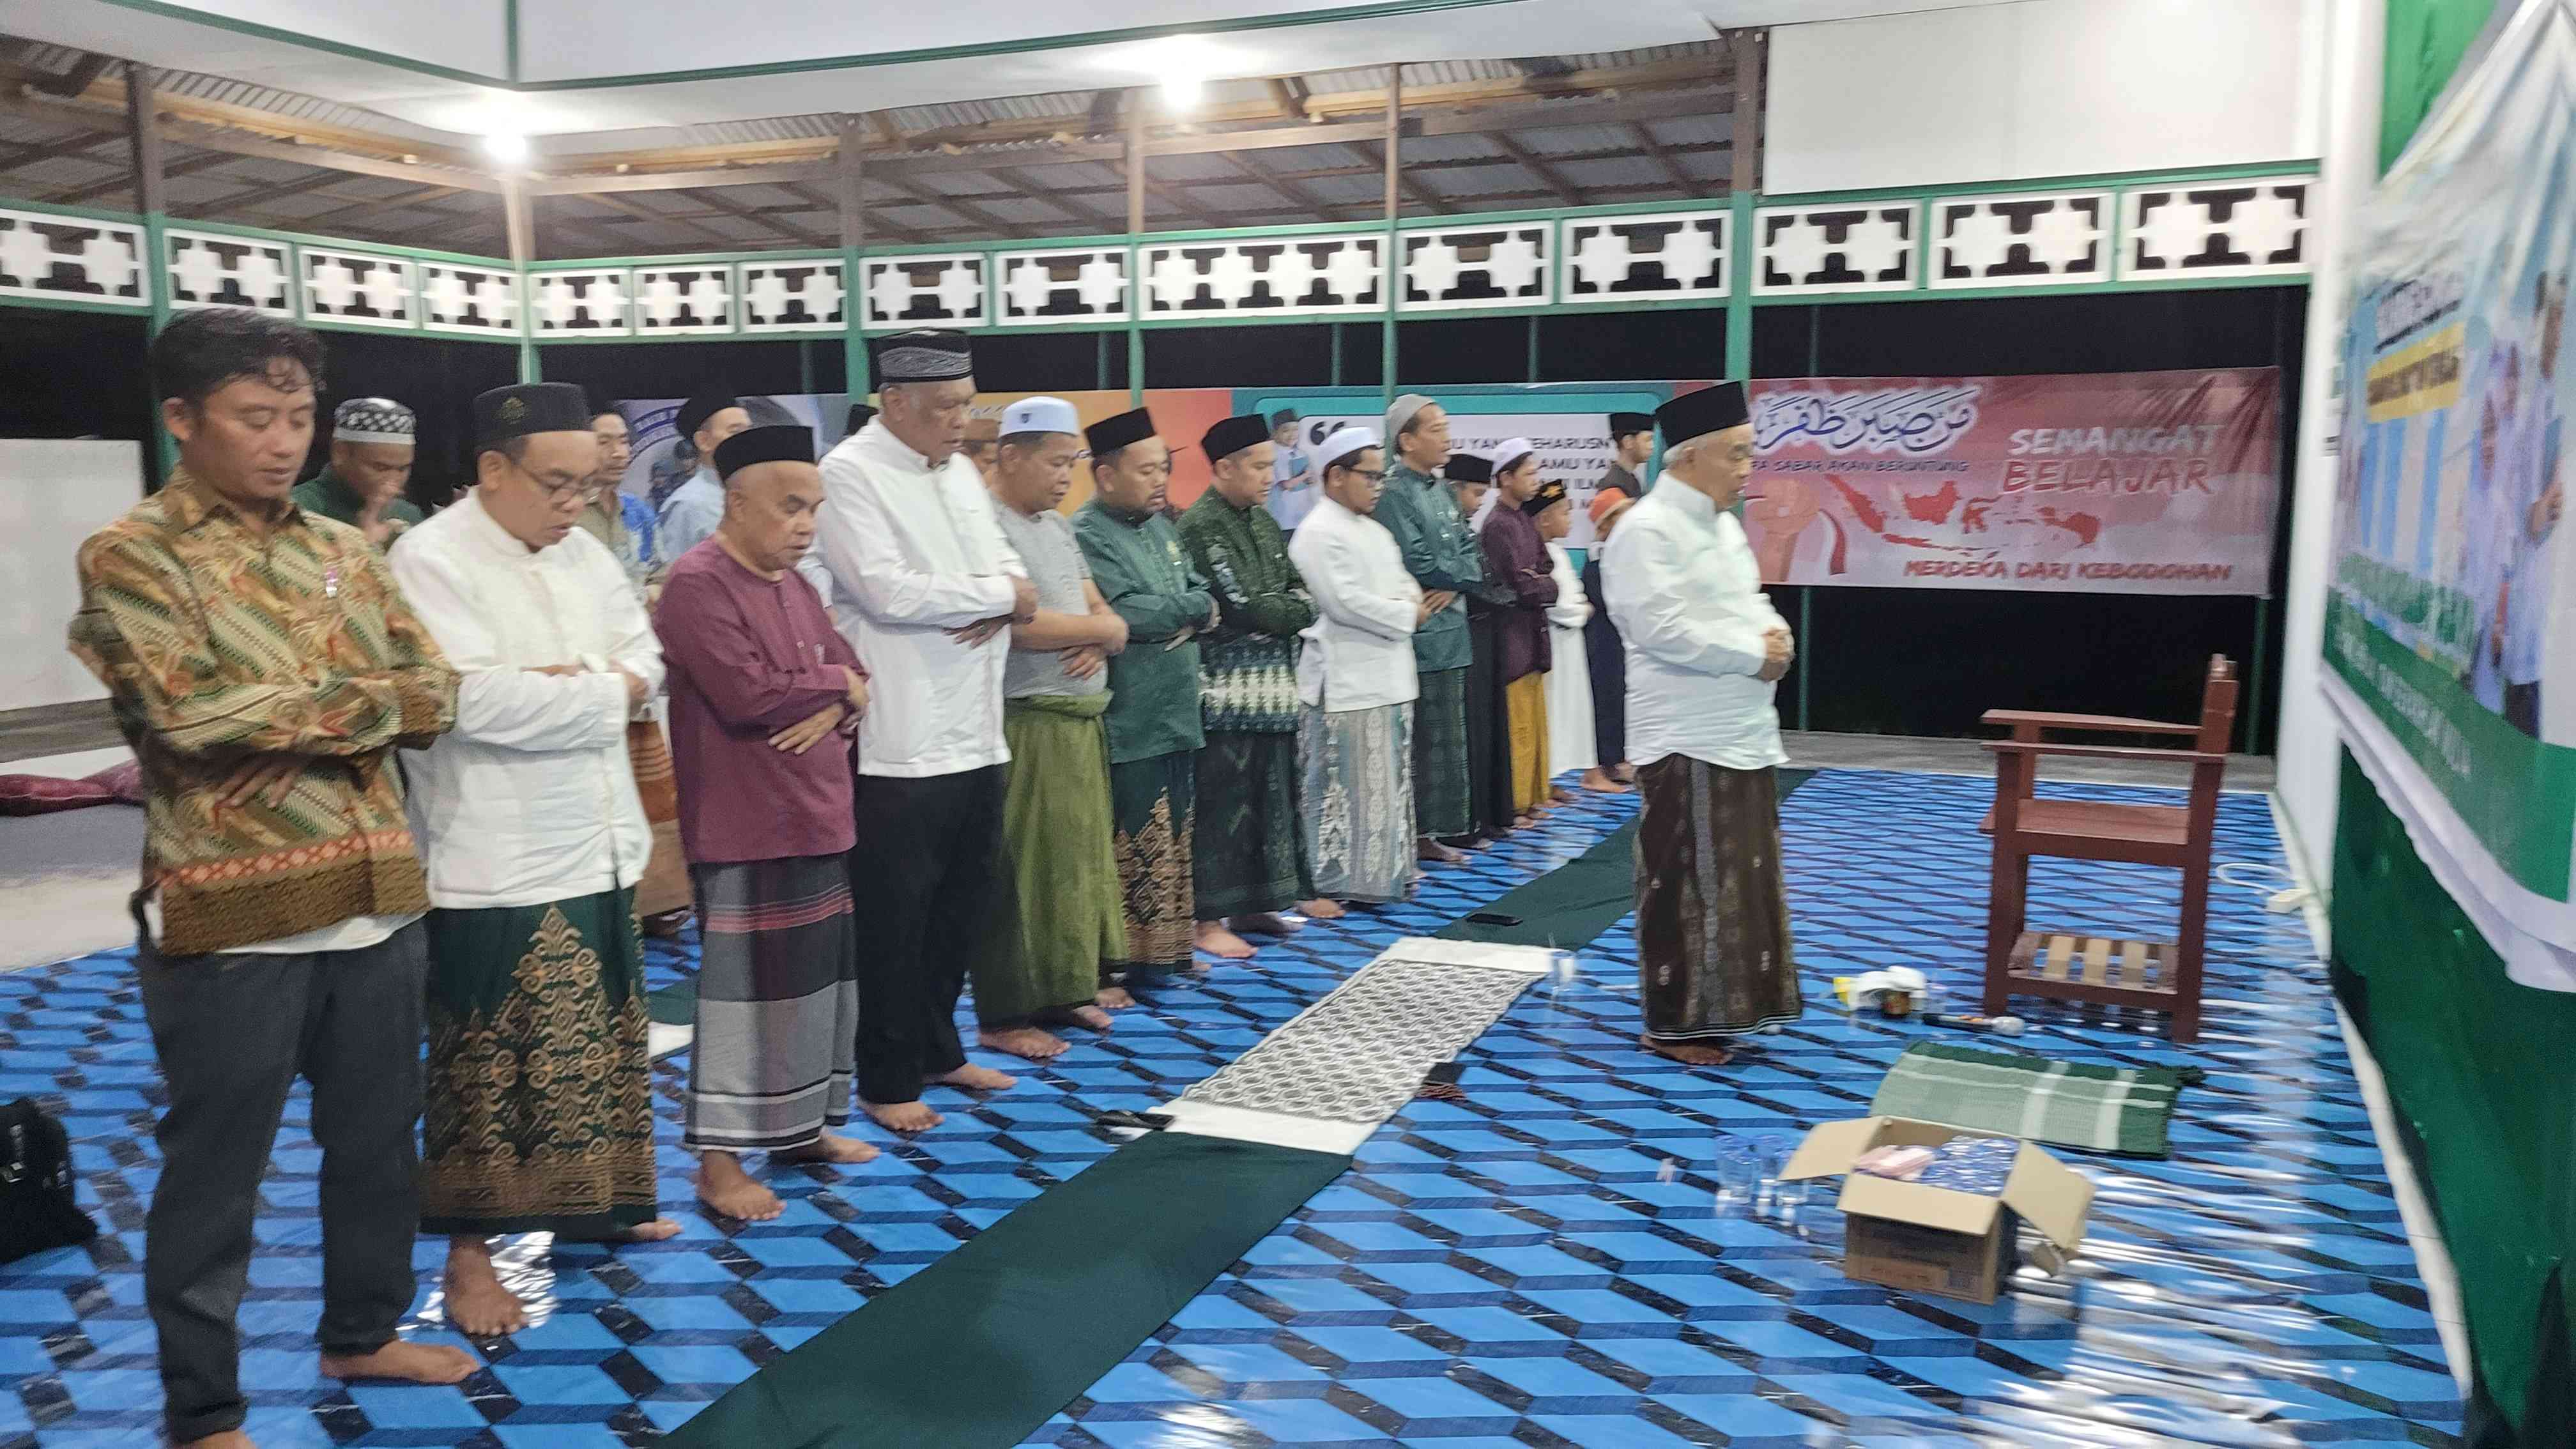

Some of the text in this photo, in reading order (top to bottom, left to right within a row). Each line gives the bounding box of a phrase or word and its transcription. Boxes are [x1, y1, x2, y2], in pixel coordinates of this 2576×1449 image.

[2007, 425, 2223, 456] SEMANGAT
[1538, 457, 1581, 470] AMU
[2002, 457, 2211, 494] BELAJAR
[1903, 560, 2234, 581] MERDEKA DARI KEBODOHAN
